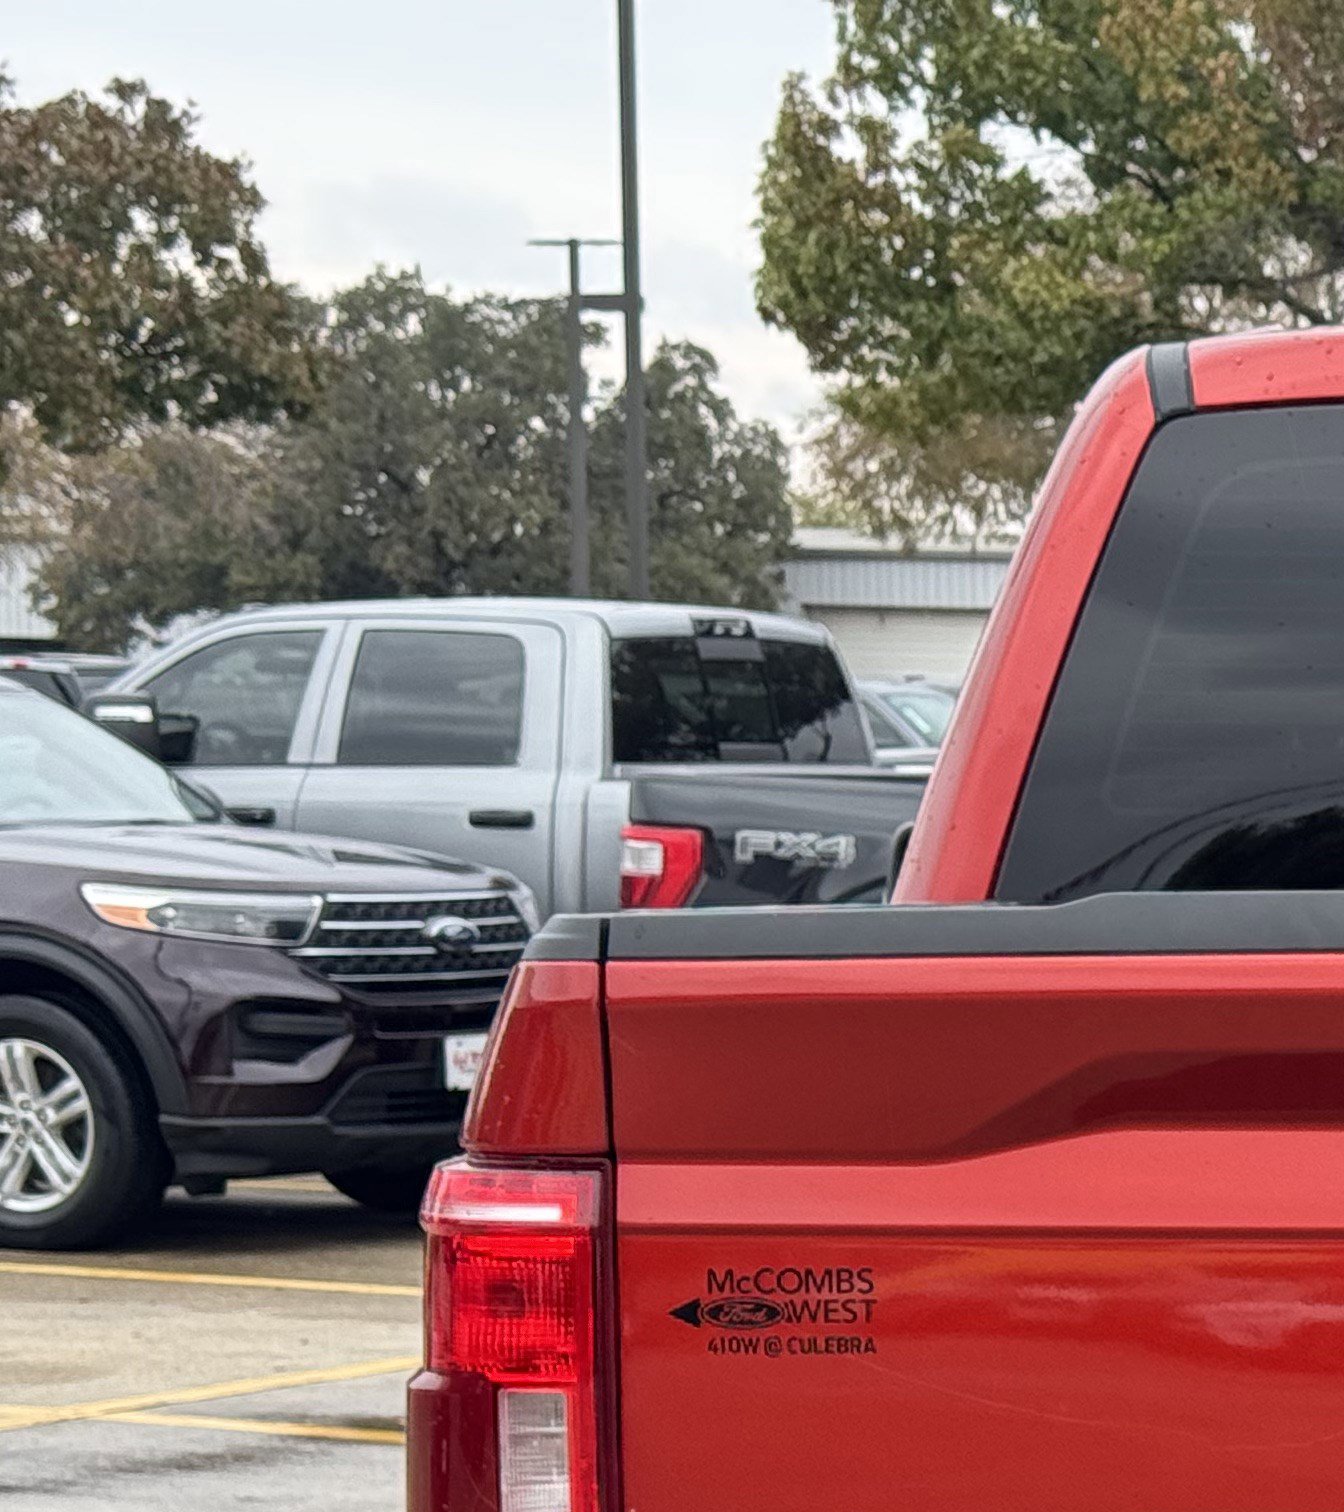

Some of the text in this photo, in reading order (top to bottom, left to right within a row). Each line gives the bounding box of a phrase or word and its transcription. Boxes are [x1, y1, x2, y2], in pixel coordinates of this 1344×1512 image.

[735, 829, 857, 869] FX4
[707, 1267, 875, 1295] McCOMBS
[786, 1299, 877, 1324] WEST
[707, 1336, 760, 1355] 410W
[786, 1335, 878, 1355] CULEBRA
